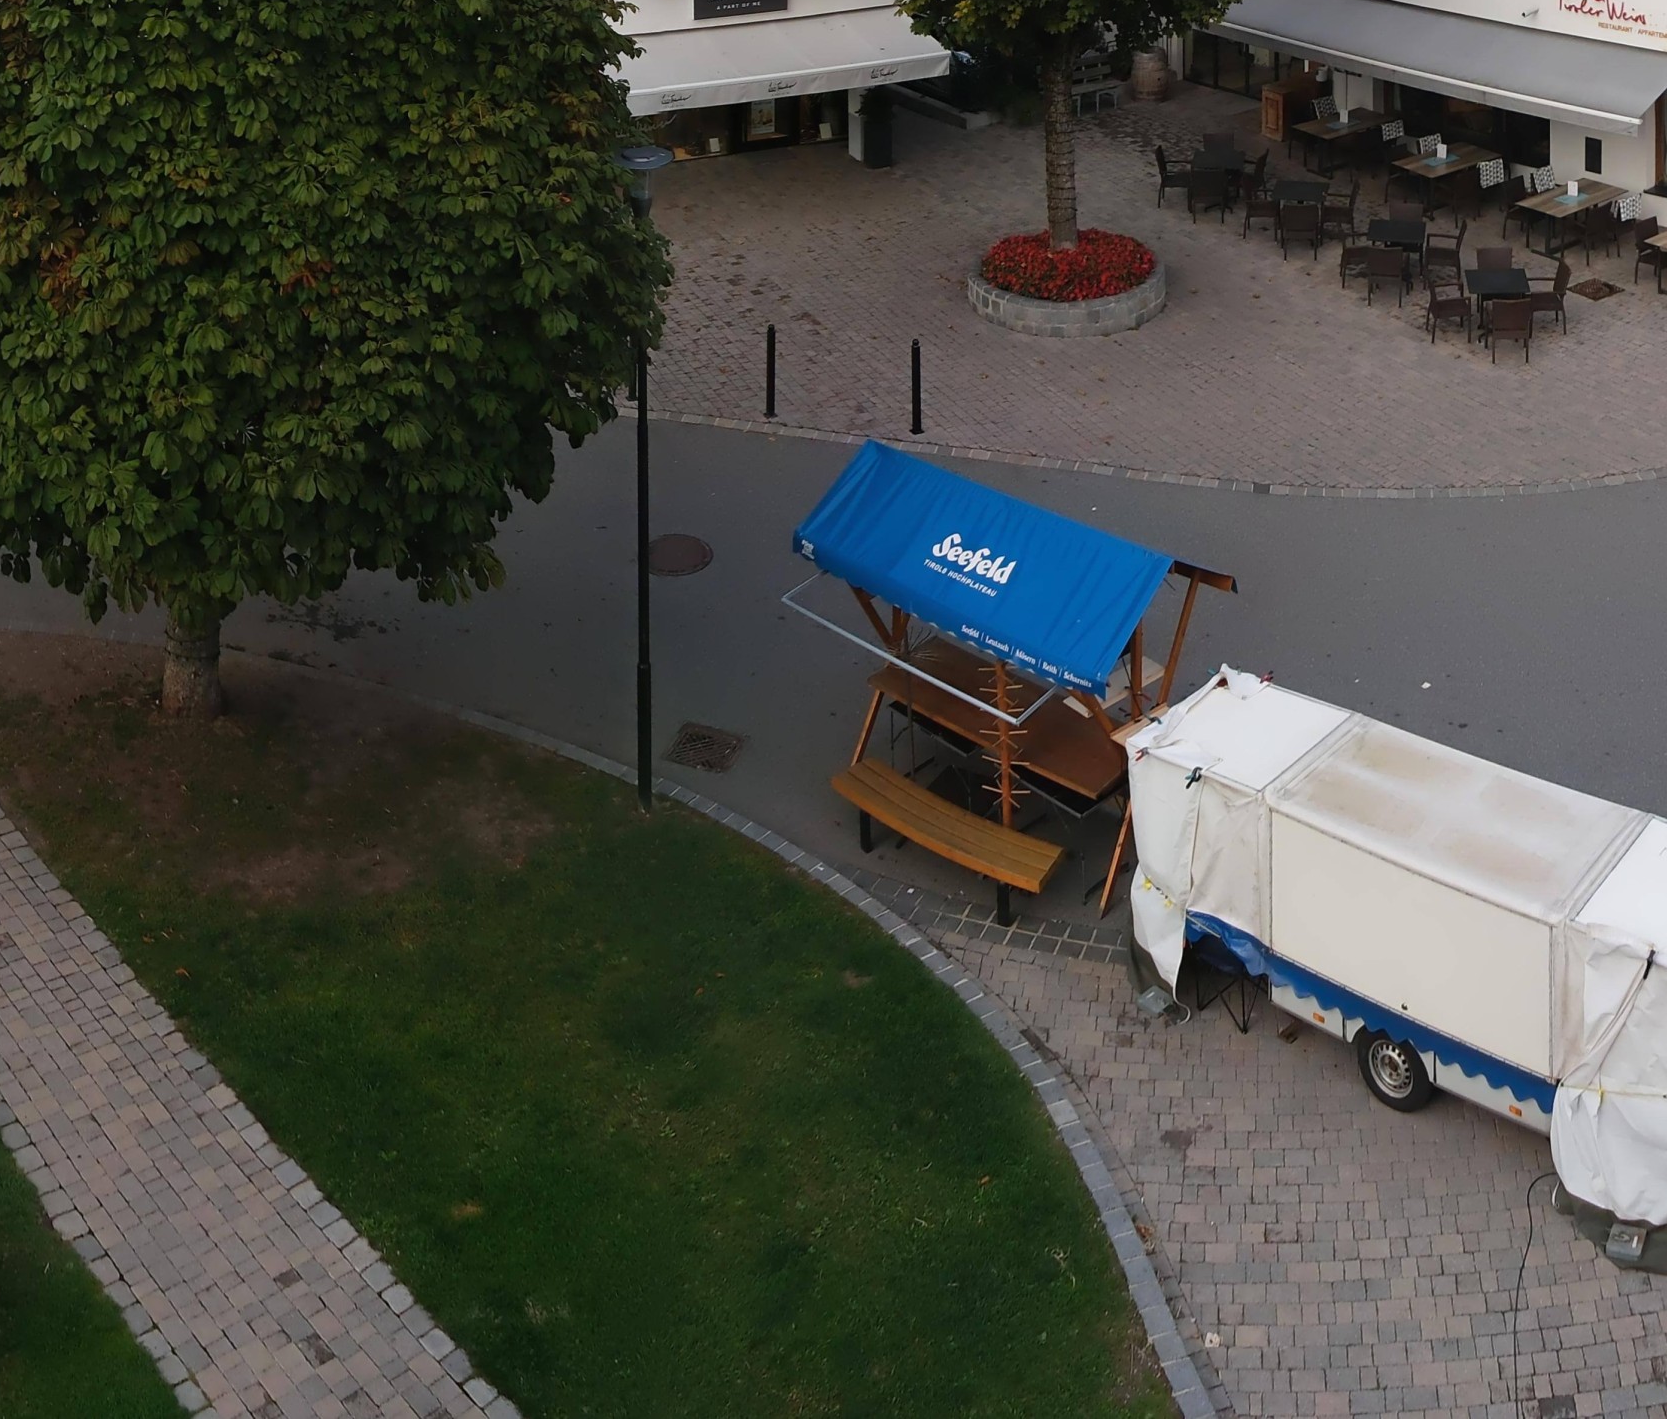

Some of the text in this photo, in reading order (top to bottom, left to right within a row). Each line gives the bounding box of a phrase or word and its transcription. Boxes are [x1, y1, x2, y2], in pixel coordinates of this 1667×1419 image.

[1598, 21, 1633, 33] RESTAURANT
[923, 557, 947, 575] TIROLS
[931, 532, 1018, 585] Seefeld
